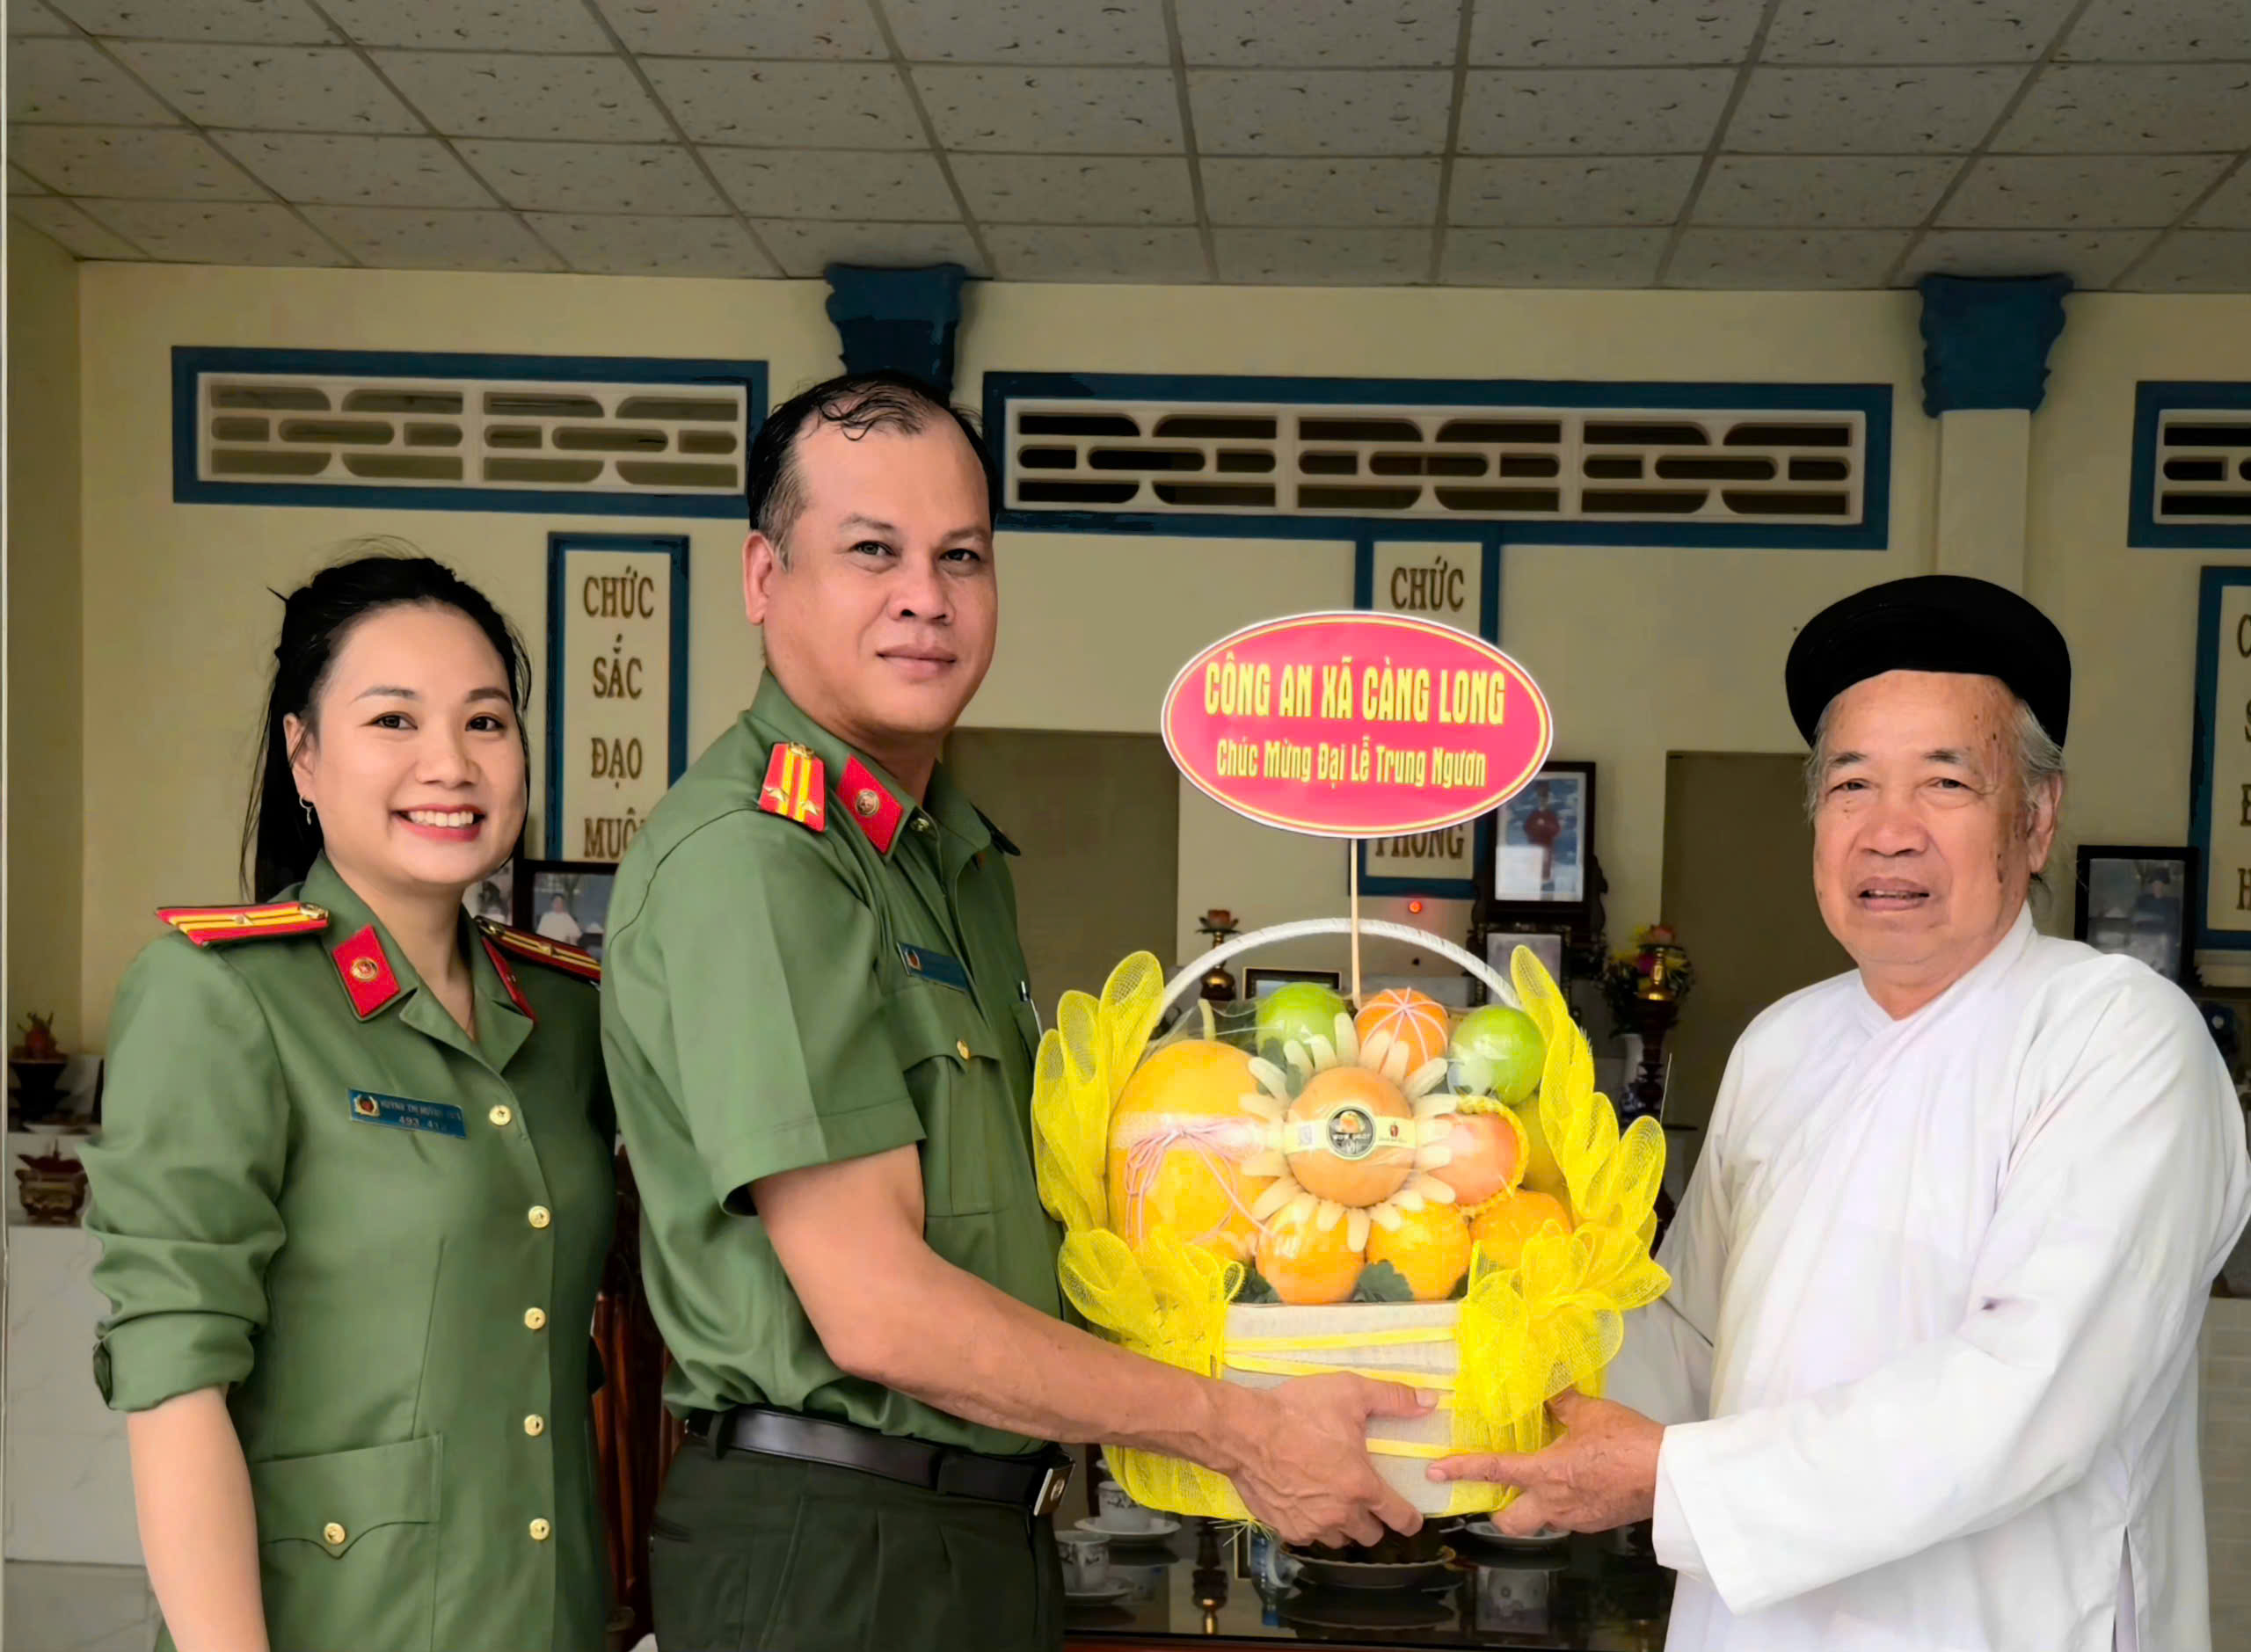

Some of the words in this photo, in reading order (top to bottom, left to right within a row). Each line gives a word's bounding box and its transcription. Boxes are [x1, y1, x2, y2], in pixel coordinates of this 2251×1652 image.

[583, 565, 654, 619] CHỨC
[1390, 556, 1464, 612] CHỨC
[593, 633, 643, 700] SẮC
[1205, 651, 1271, 717] CÔNG
[1278, 664, 1313, 717] AN
[1321, 656, 1353, 720] XÃ
[1363, 656, 1431, 724] CÀNG
[1439, 669, 1505, 725] LONG
[591, 738, 643, 790] ĐẠO
[1217, 736, 1259, 777] Chúc
[1264, 738, 1312, 783] Mừng
[1317, 742, 1346, 790] Đại
[1351, 735, 1371, 782] Lễ
[1376, 745, 1427, 788] Trung
[1431, 747, 1486, 789] Ngươn
[584, 806, 645, 859] MUÔ
